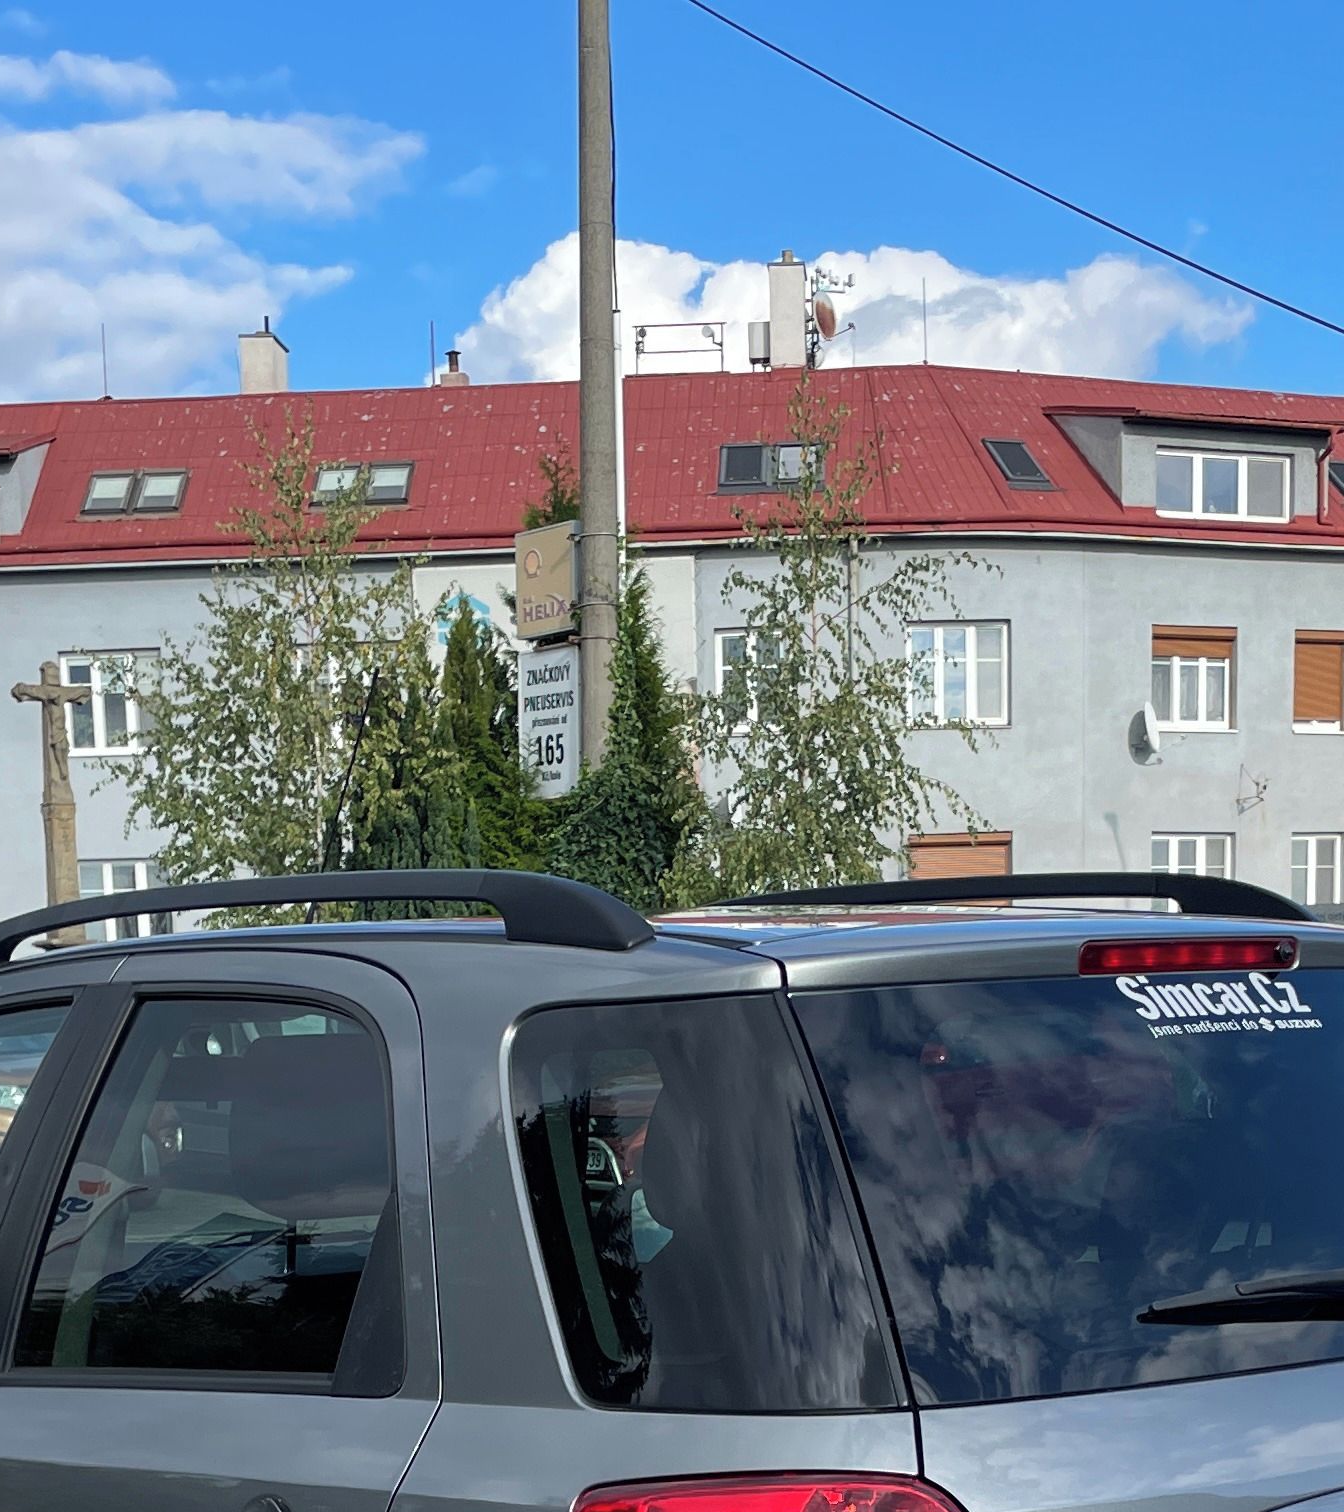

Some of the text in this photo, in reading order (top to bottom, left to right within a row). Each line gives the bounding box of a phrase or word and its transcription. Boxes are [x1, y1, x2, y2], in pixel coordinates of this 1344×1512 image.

[523, 599, 566, 623] HELIX
[526, 660, 570, 686] ZNAČKOVÝ
[524, 690, 574, 712] PNEUSERVIS
[535, 733, 565, 766] 165
[1115, 971, 1312, 1020] Simcar.Cz
[1147, 1018, 1324, 1039] jsme nadšenci do SUZUKI
